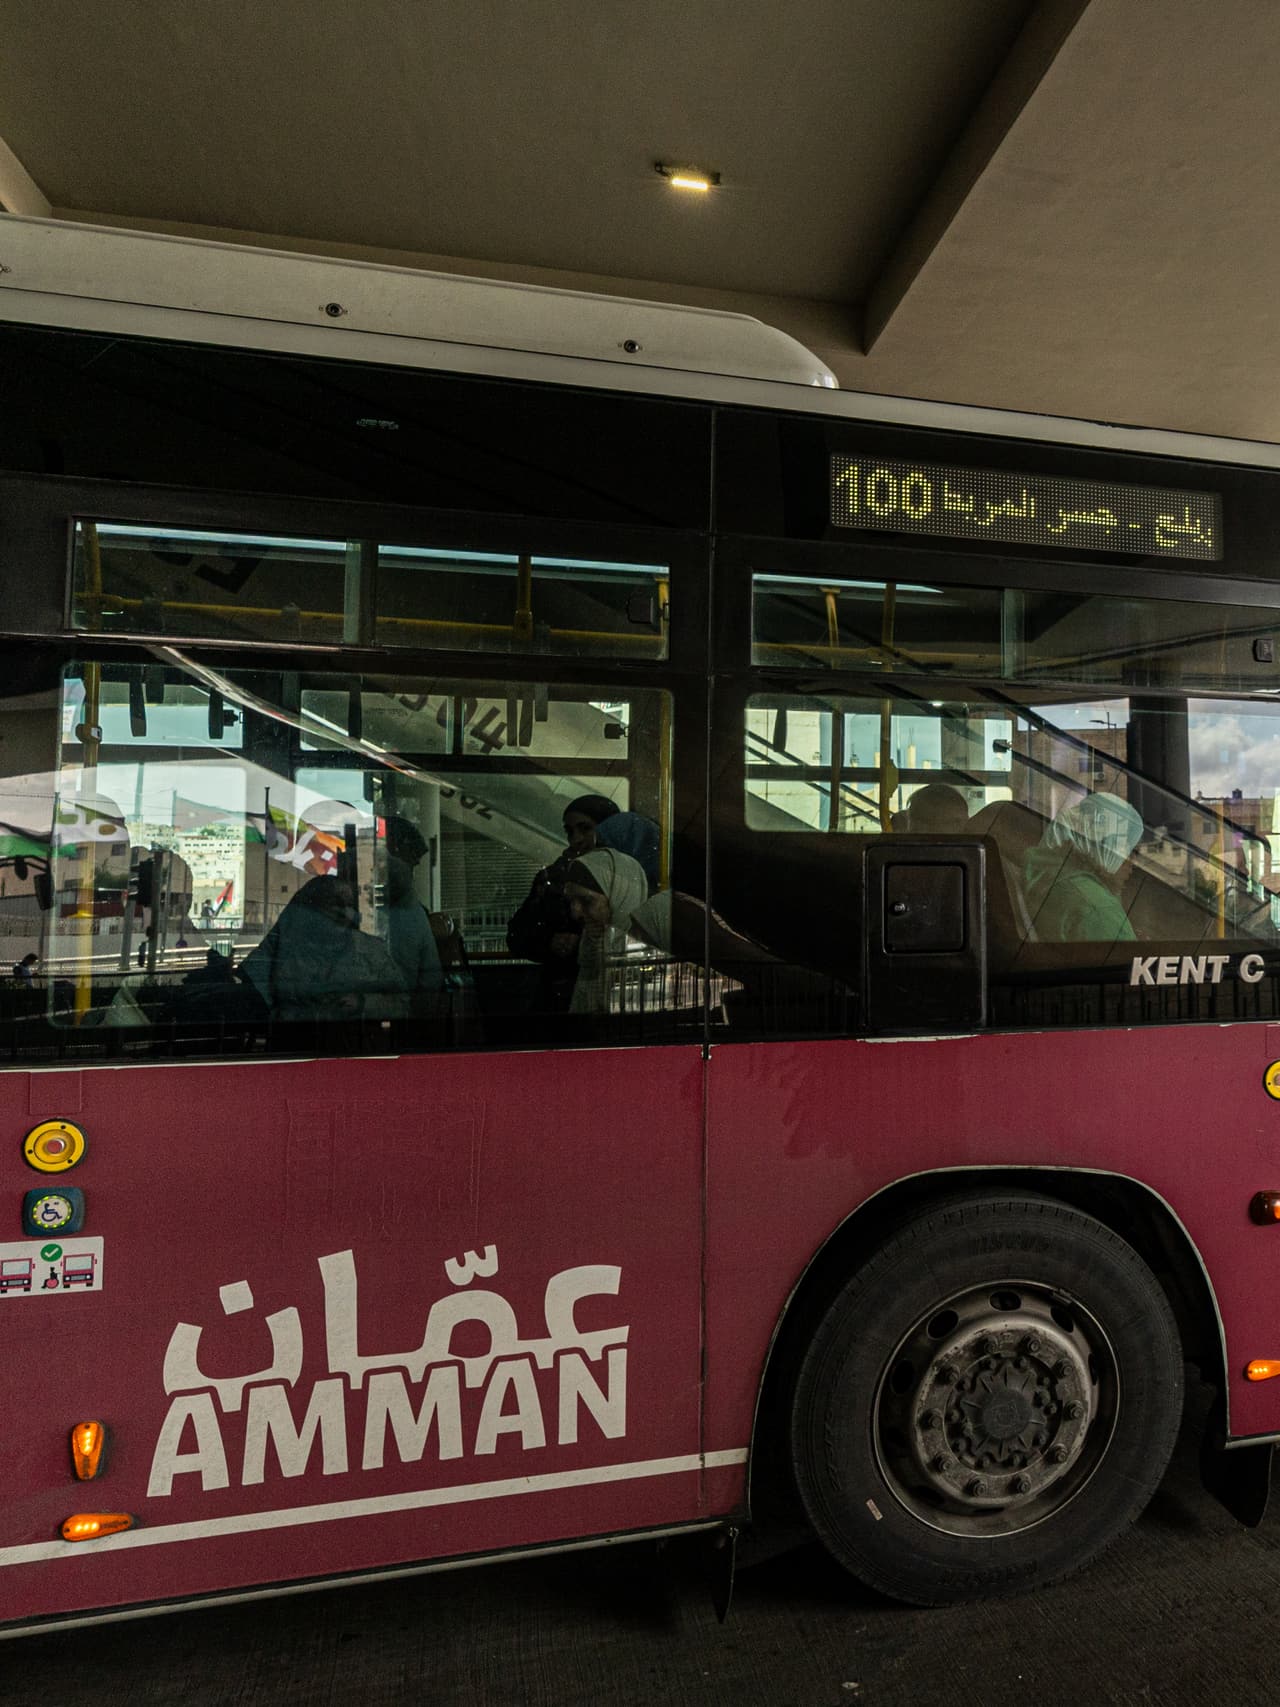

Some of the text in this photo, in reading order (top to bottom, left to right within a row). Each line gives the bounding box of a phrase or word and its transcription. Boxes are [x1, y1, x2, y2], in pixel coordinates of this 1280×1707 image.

[834, 464, 933, 520] 100
[1046, 508, 1118, 534] جسر
[1130, 954, 1265, 986] KENT C
[147, 1348, 628, 1498] AMMAN
